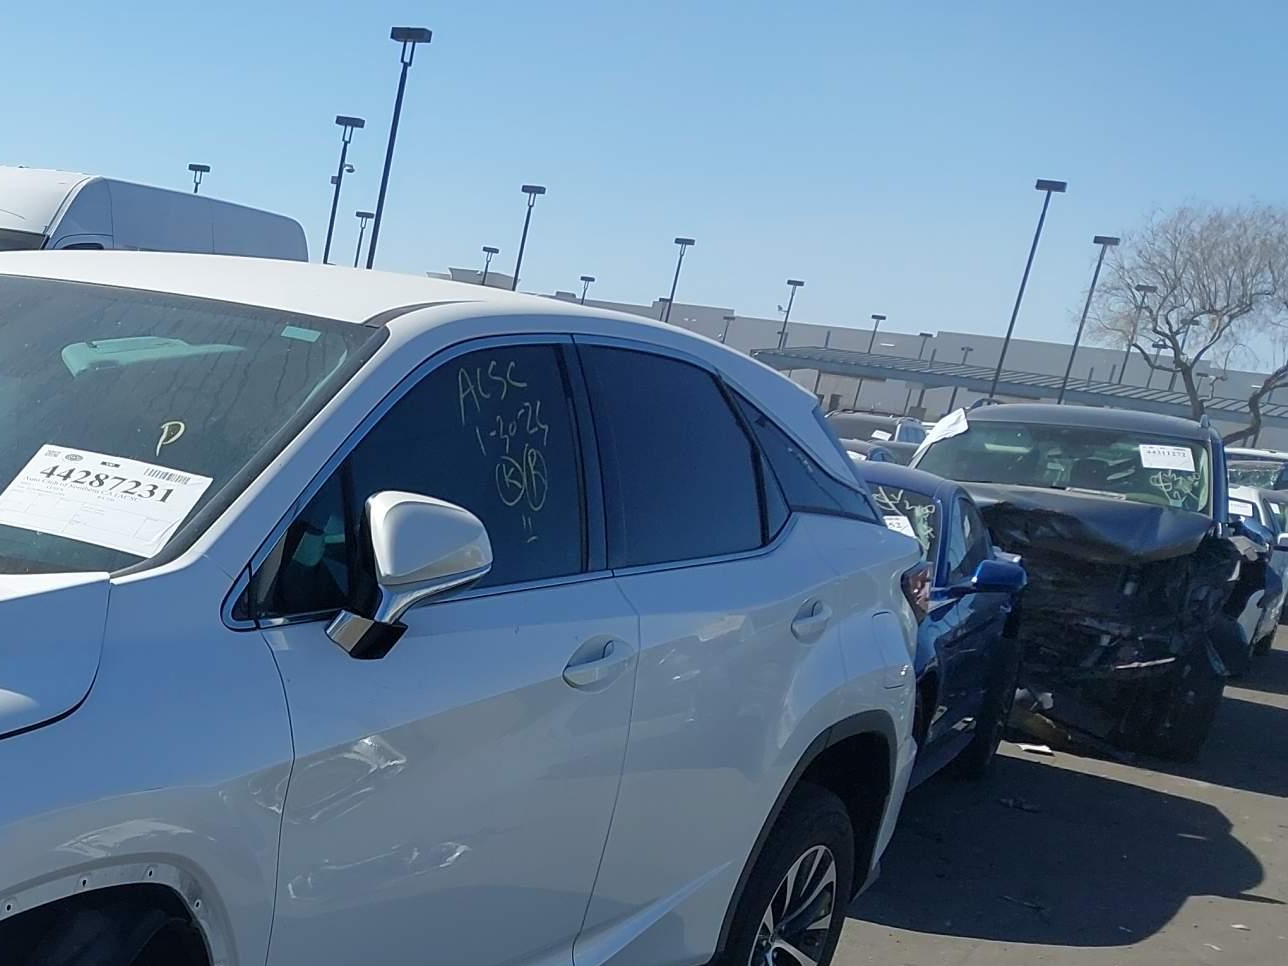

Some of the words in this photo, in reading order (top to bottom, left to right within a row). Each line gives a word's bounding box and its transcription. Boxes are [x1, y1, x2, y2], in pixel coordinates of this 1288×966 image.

[458, 360, 528, 426] ACSC
[155, 420, 186, 457] P
[39, 464, 175, 504] 44287231
